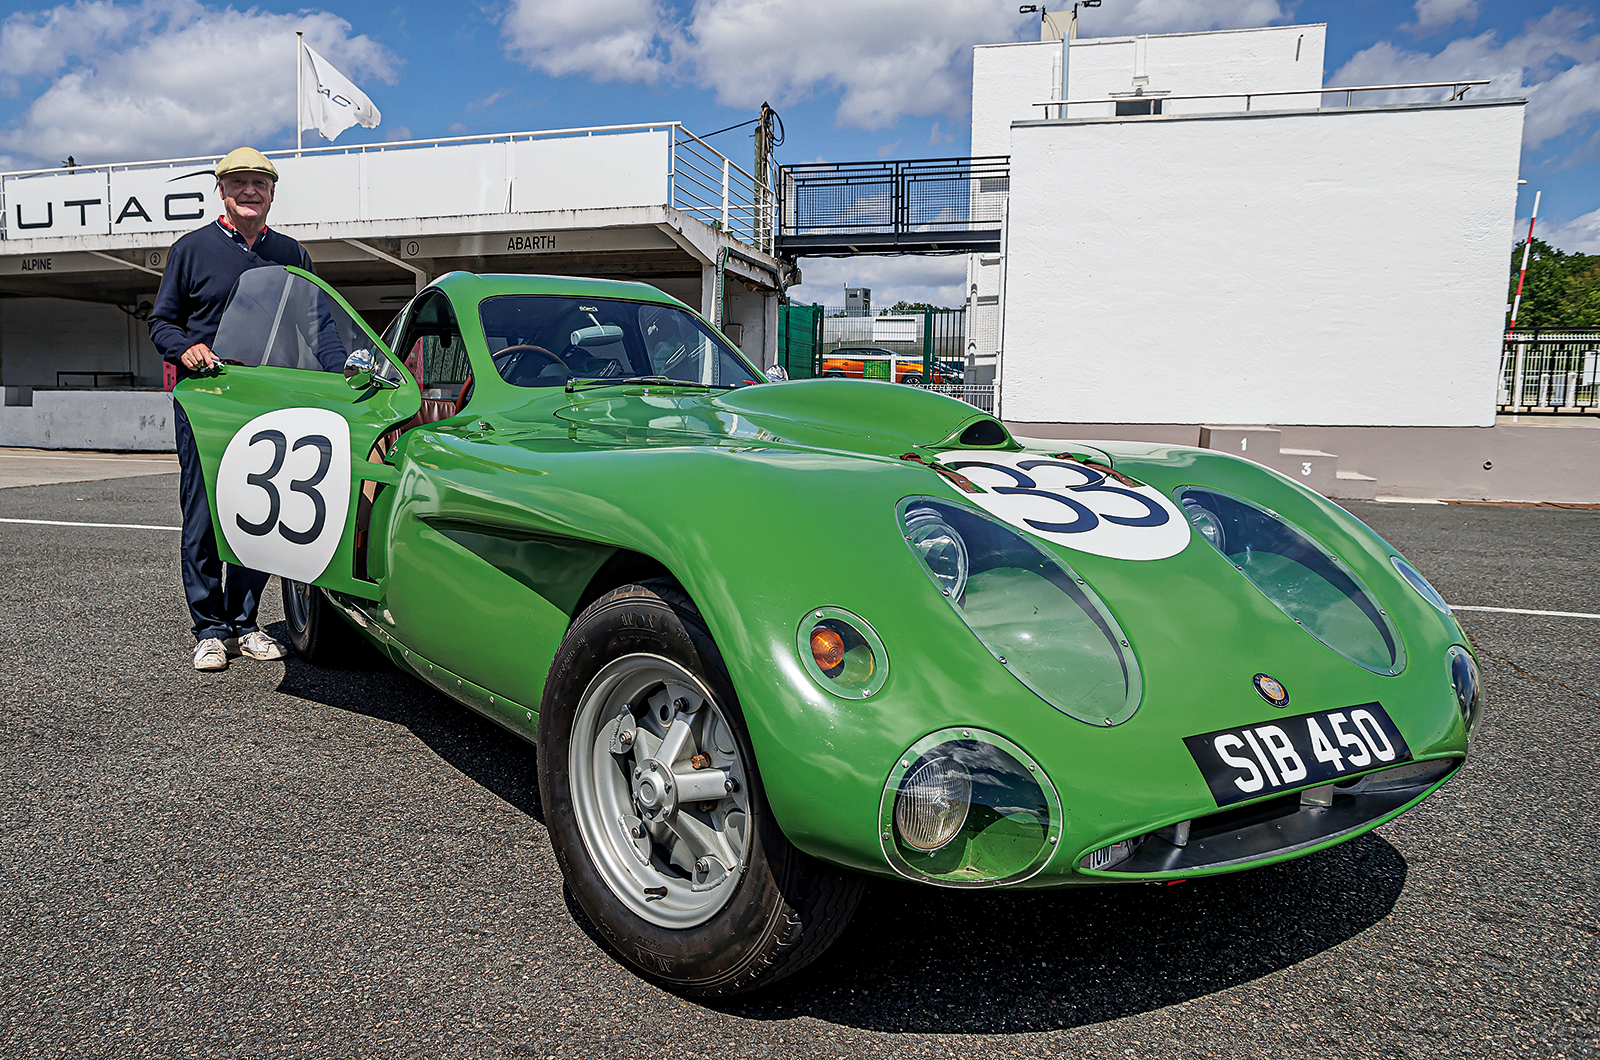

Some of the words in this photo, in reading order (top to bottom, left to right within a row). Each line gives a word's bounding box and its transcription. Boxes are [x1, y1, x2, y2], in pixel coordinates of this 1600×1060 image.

[16, 192, 204, 229] UTAC
[507, 236, 556, 250] ABARTH
[22, 258, 52, 270] ALPINE
[1241, 438, 1247, 450] 1
[1301, 462, 1312, 476] 3
[236, 429, 332, 545] 33
[944, 460, 1170, 533] 33
[1214, 724, 1307, 792] SIB
[1306, 709, 1396, 772] 450
